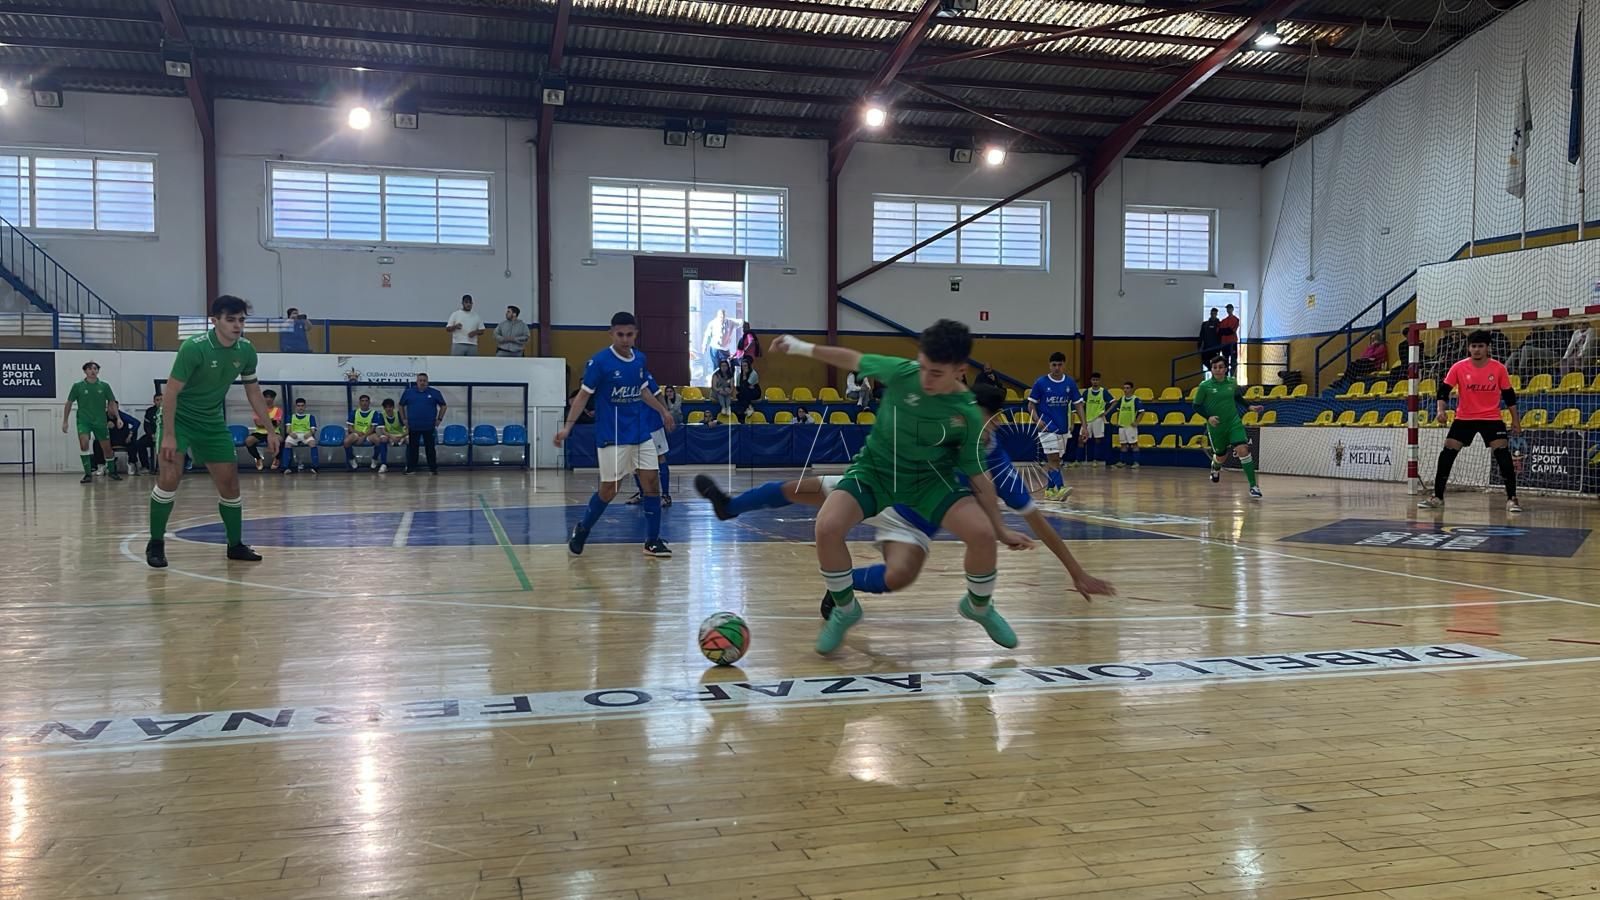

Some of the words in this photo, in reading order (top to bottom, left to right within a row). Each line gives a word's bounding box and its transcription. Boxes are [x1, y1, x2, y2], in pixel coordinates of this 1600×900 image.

[2, 363, 41, 371] MELILLA
[2, 371, 34, 379] SPORT
[1532, 445, 1568, 455] MELILLA
[1349, 452, 1392, 465] MELILLA
[1532, 454, 1561, 464] SPORT
[1531, 464, 1568, 474] CAPITAL
[1022, 644, 1479, 683] PABELLÓN
